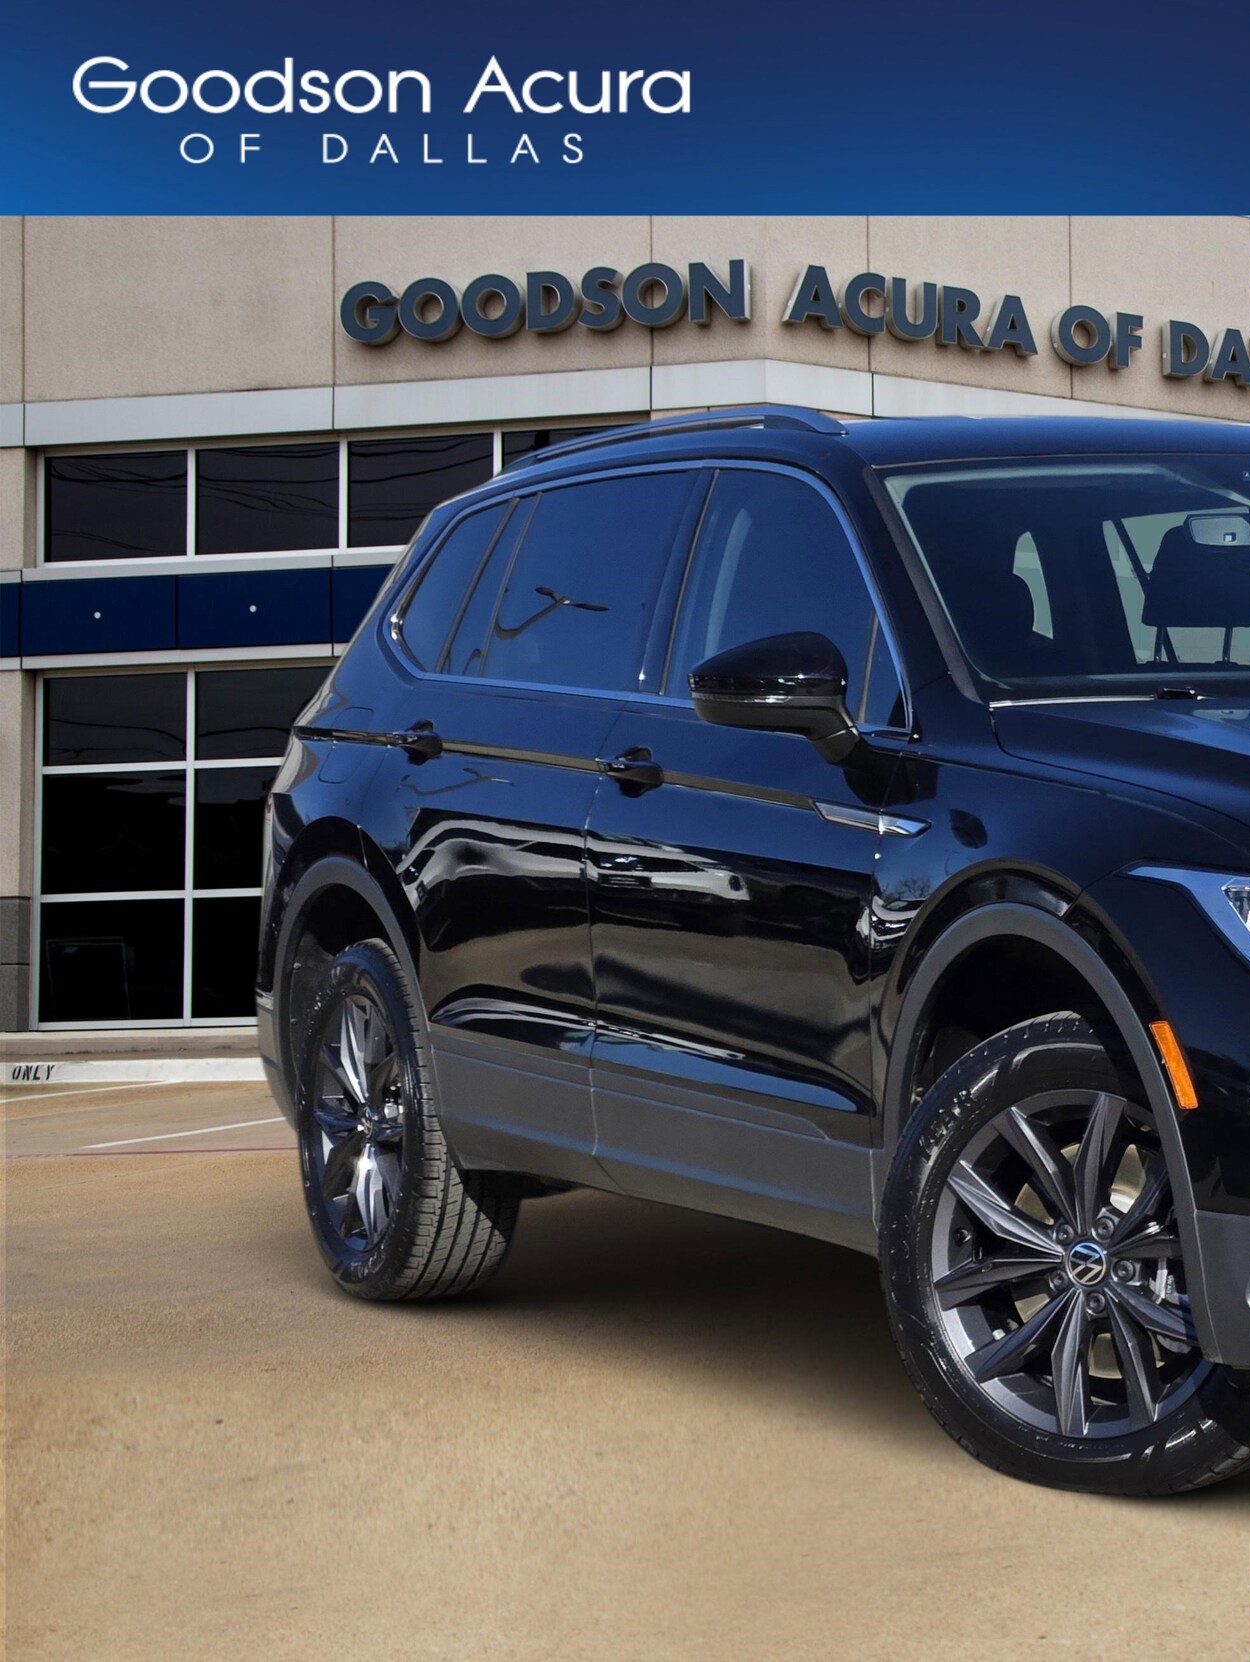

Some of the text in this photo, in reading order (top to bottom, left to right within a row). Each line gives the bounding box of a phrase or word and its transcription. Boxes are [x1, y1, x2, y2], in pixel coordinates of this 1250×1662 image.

[340, 258, 752, 347] GOODSON
[782, 264, 1038, 357] ACURA
[1051, 304, 1144, 370] OF
[11, 1064, 55, 1081] ONLY
